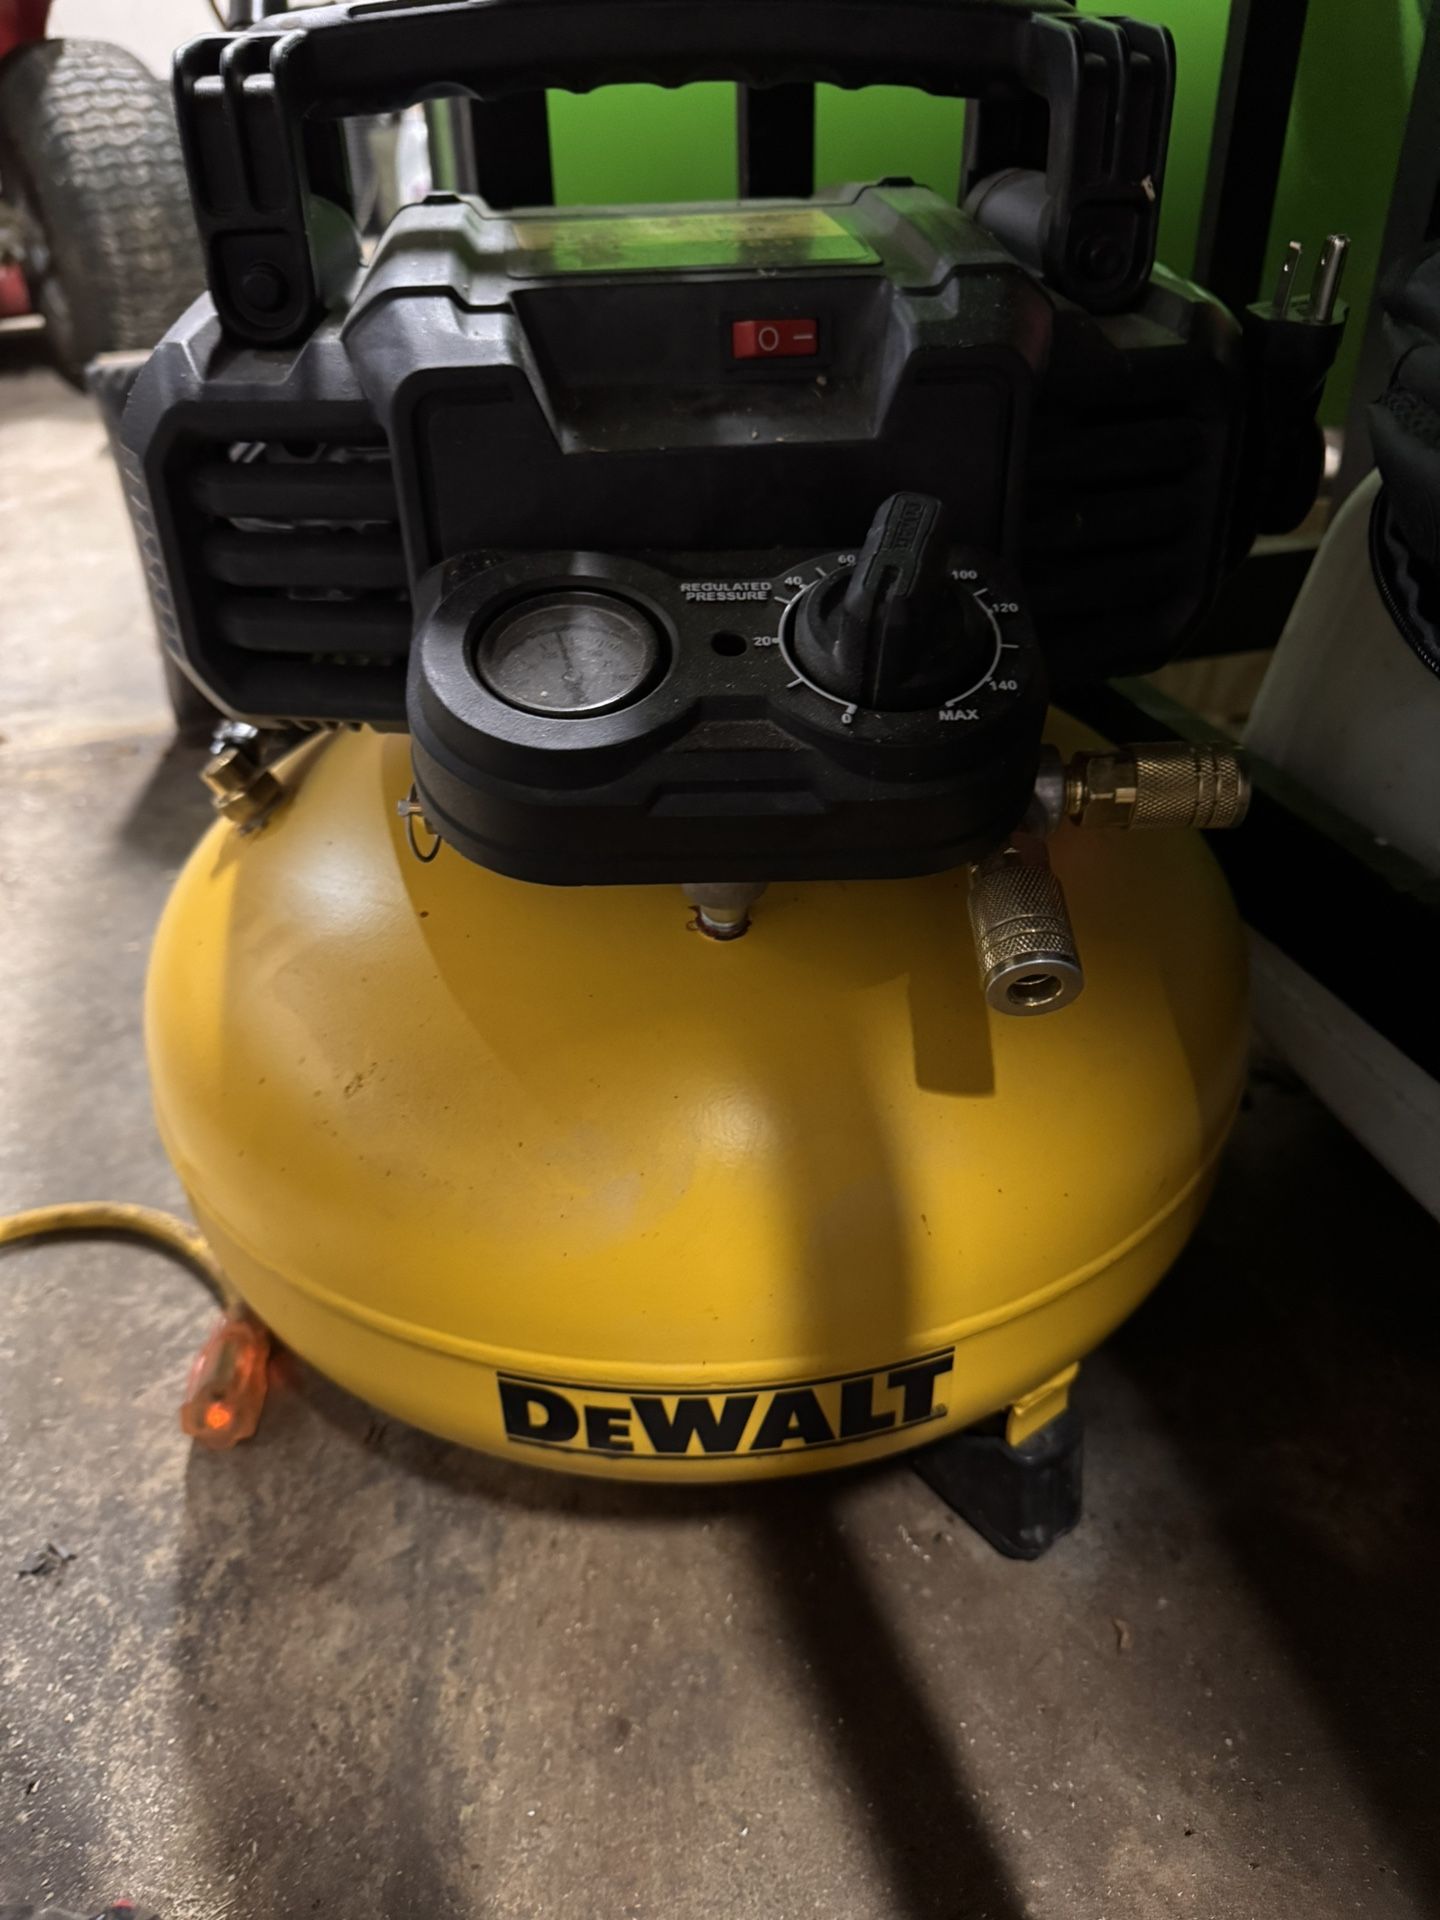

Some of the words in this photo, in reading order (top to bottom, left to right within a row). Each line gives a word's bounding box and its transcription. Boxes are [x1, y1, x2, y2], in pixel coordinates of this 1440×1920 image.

[837, 553, 857, 565] 60
[951, 569, 978, 580] 100
[784, 576, 803, 587] 40
[680, 582, 774, 593] REGULATED
[686, 591, 770, 602] PRESSURE
[991, 602, 1019, 613] 120
[753, 636, 773, 648] 20
[988, 680, 1018, 692] 140
[841, 713, 853, 725] 0
[938, 708, 980, 722] MAX
